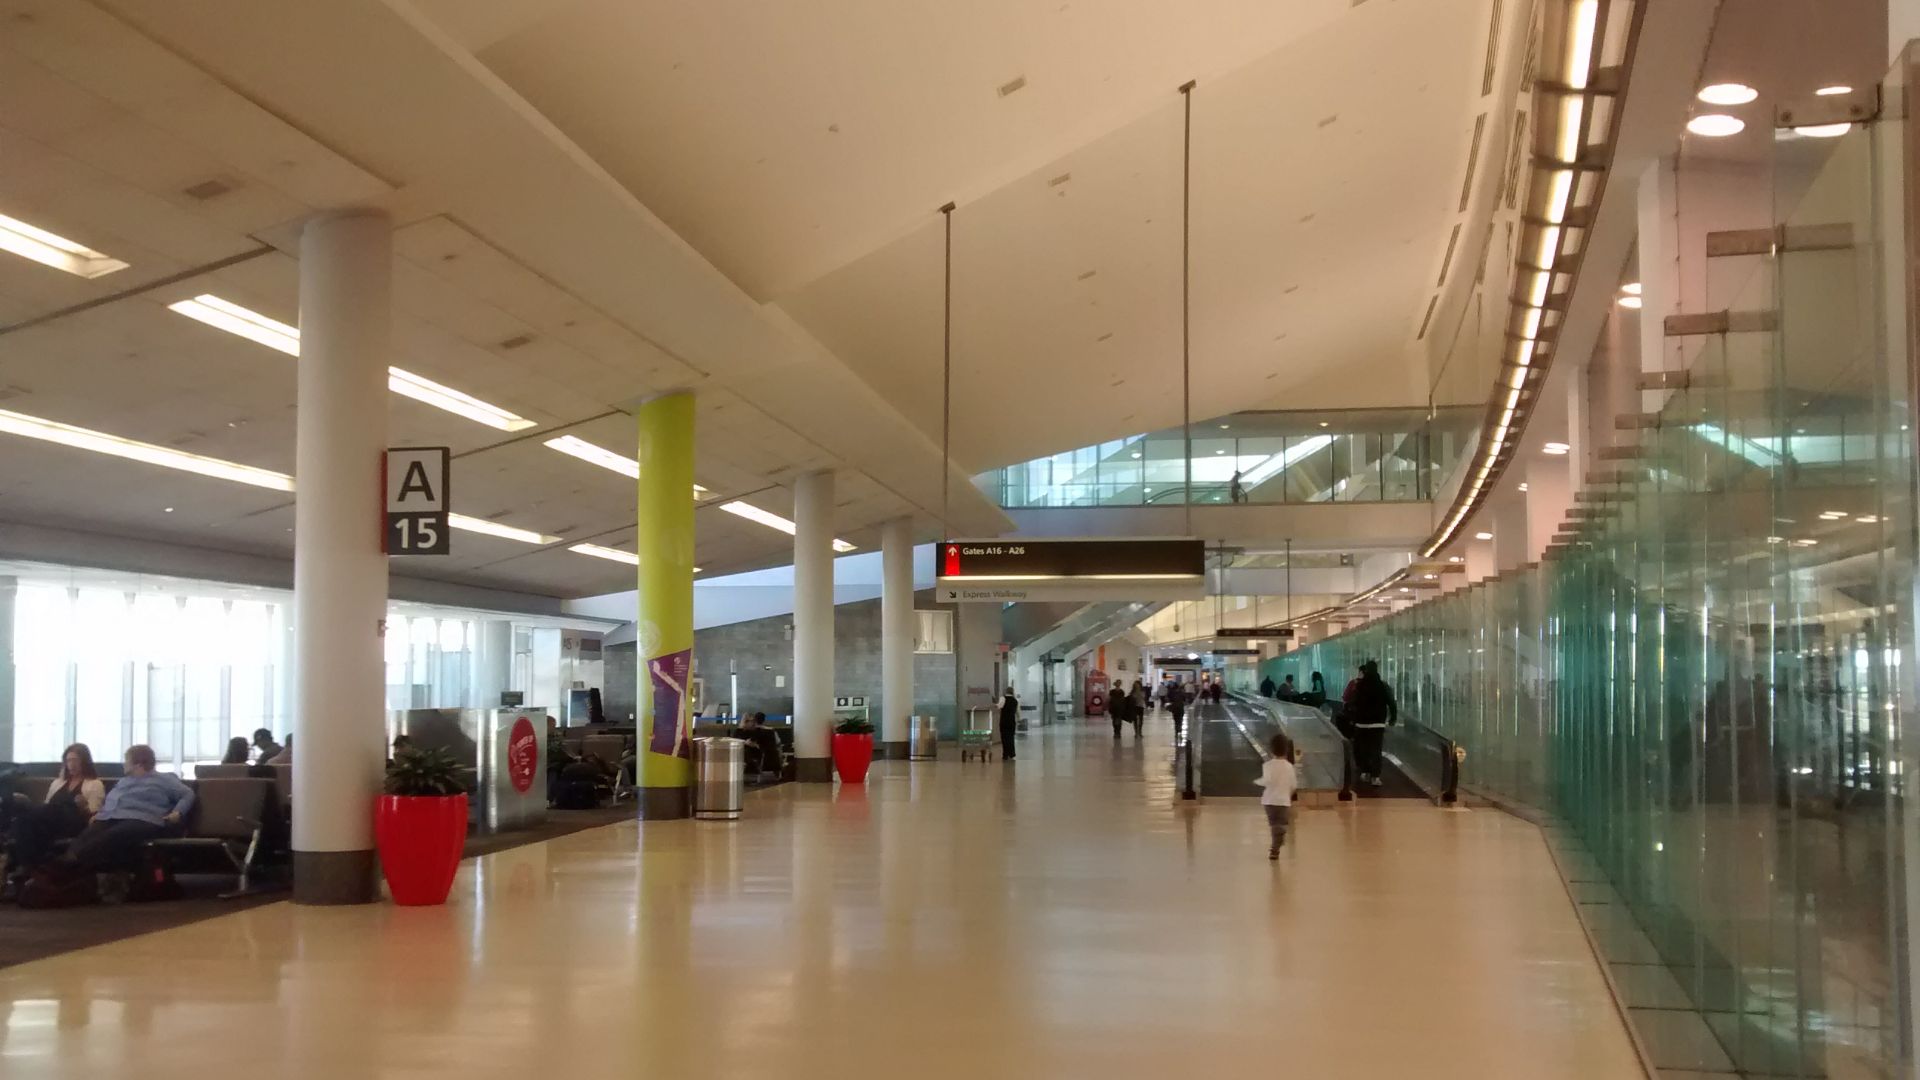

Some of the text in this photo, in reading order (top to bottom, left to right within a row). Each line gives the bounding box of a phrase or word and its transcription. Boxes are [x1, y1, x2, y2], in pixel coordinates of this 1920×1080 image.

[397, 461, 435, 502] A
[395, 518, 437, 549] 15
[962, 547, 984, 555] Gates
[986, 546, 1002, 555] A16
[1008, 546, 1025, 555] A26
[963, 589, 1027, 599] Express Walkway
